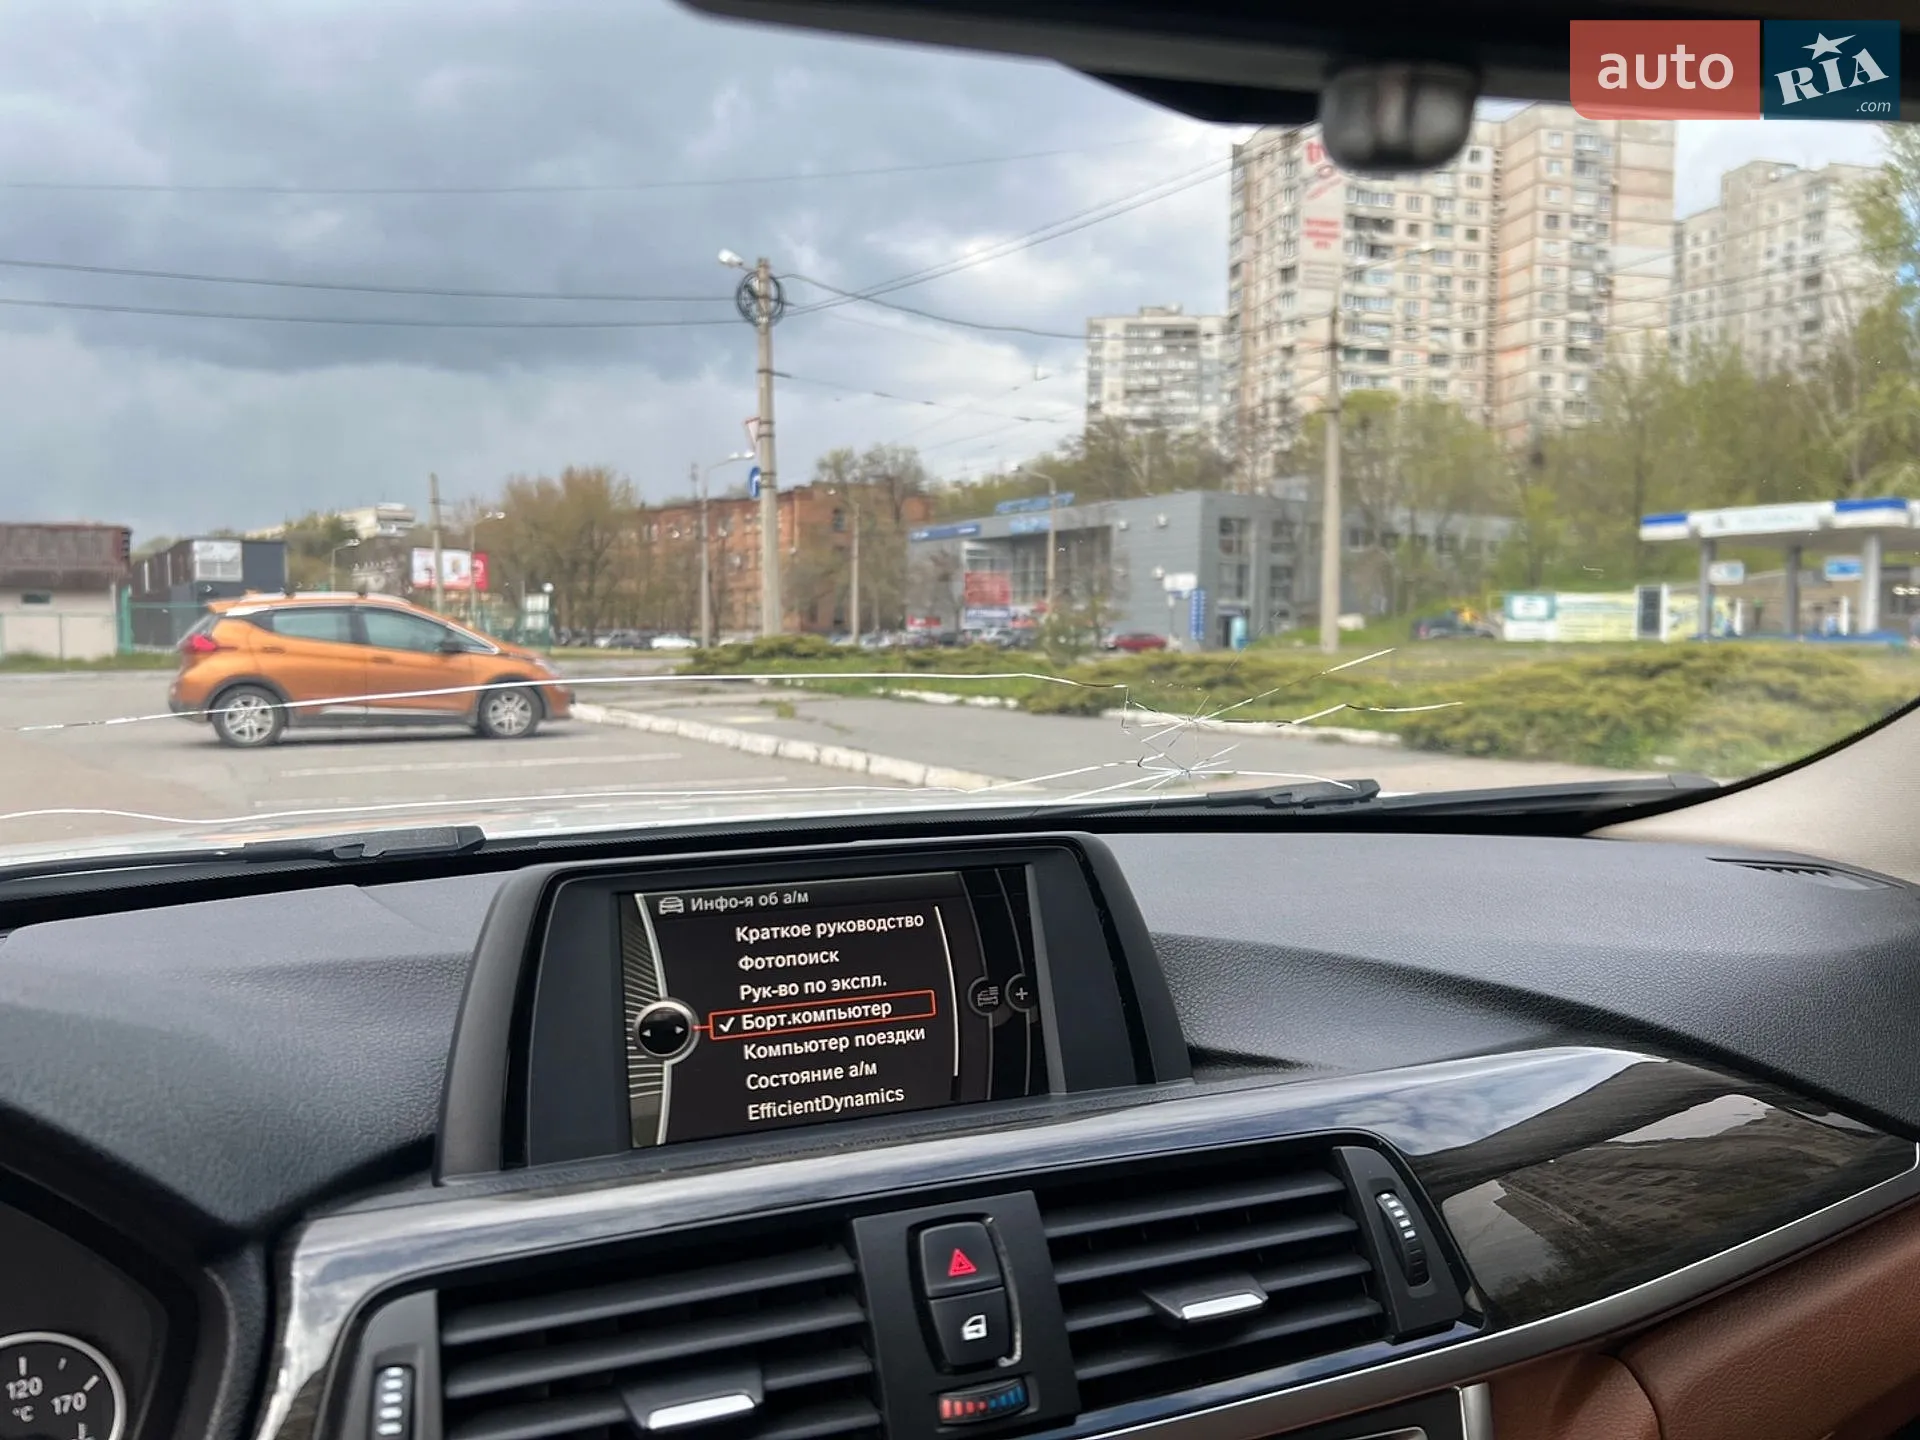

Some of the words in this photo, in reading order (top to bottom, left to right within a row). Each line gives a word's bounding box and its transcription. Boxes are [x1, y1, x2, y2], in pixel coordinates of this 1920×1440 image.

[691, 894, 753, 913] Инфо-я
[759, 892, 778, 907] об
[783, 890, 808, 906] а/м
[736, 921, 811, 944] Краткое
[817, 913, 924, 938] руководство
[738, 949, 839, 972] Фотопоиск
[739, 980, 799, 1002] Рук-во
[804, 978, 826, 994] по
[831, 973, 887, 994] экспл.
[742, 1001, 892, 1031] Борт.компьютер
[744, 1036, 849, 1060] Компьютер
[855, 1026, 925, 1048] поездки
[746, 1066, 844, 1091] Состояние
[849, 1061, 877, 1079] а/м
[748, 1087, 904, 1121] EfficientDynamics
[6, 1376, 43, 1399] 120
[12, 1405, 34, 1422] °C
[51, 1392, 87, 1415] 170
